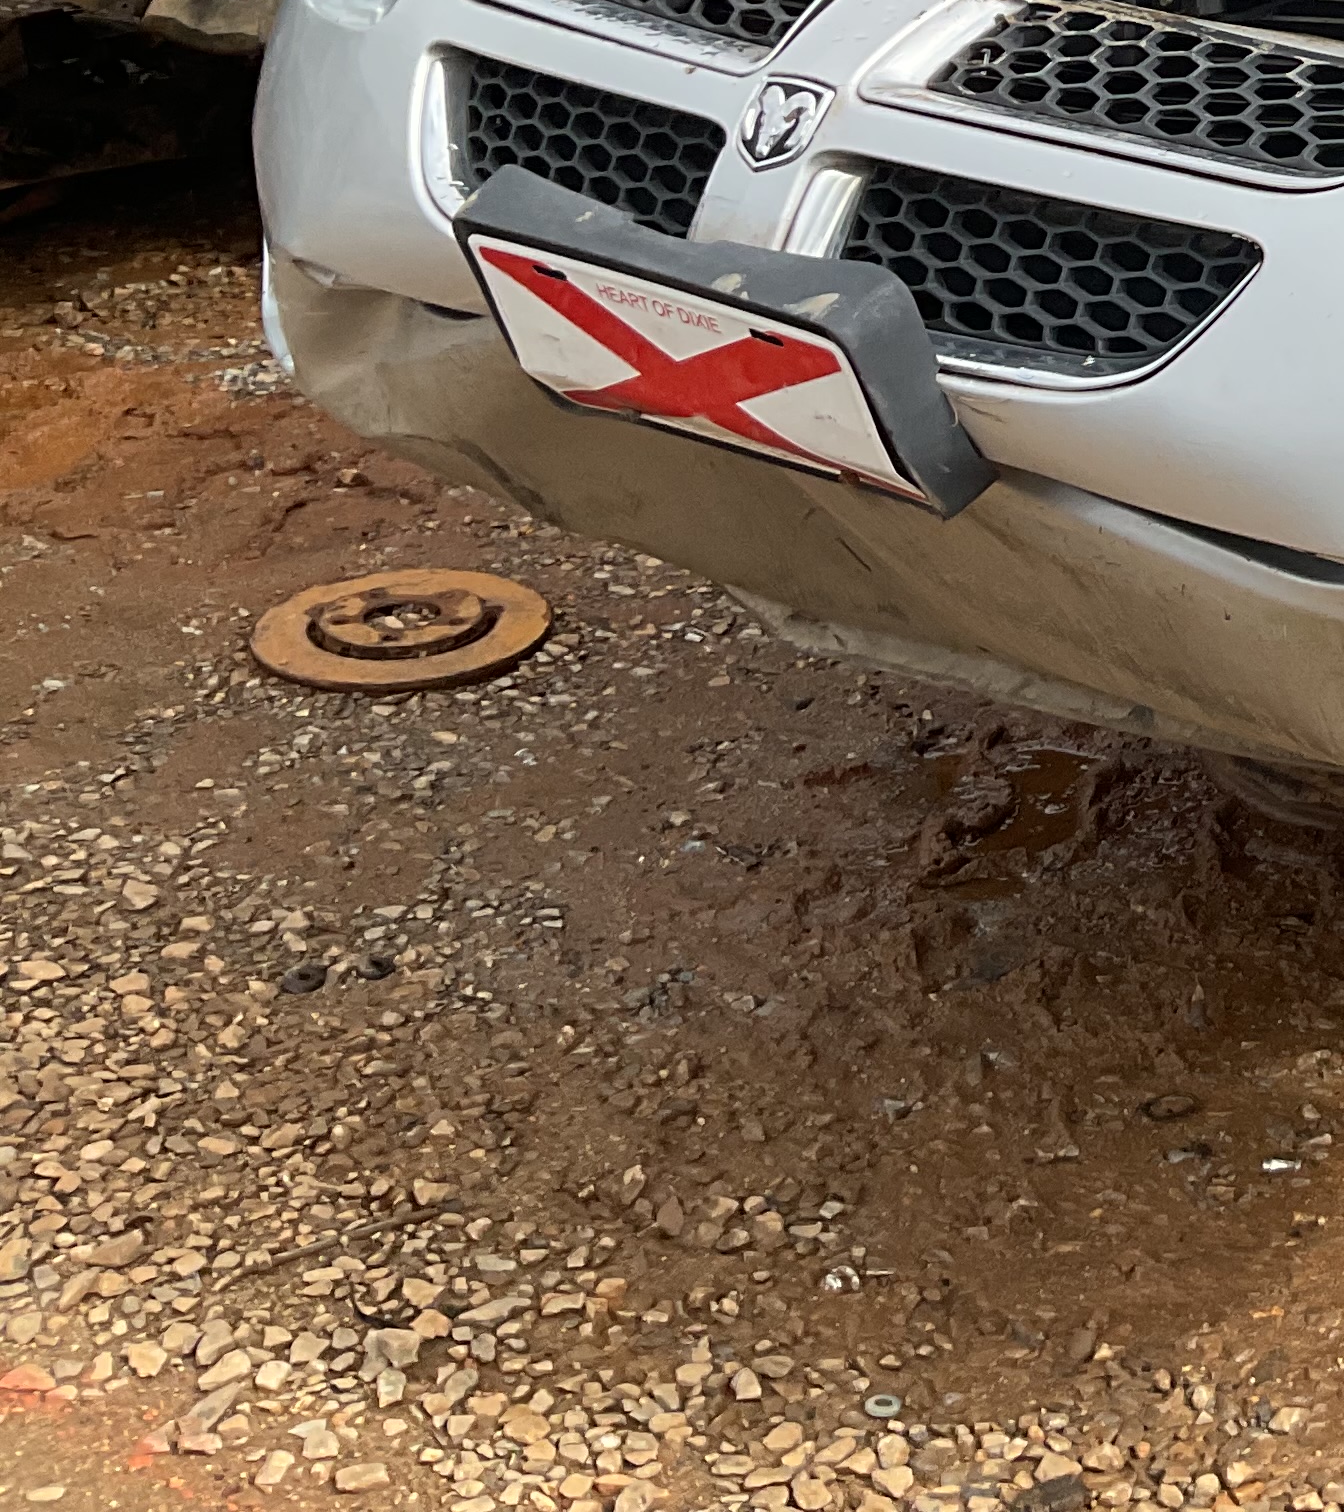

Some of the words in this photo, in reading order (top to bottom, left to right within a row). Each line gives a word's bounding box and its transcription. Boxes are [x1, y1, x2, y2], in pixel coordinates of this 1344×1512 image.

[596, 282, 650, 314] HEART
[652, 299, 676, 319] OF
[677, 306, 723, 335] DIXIE
